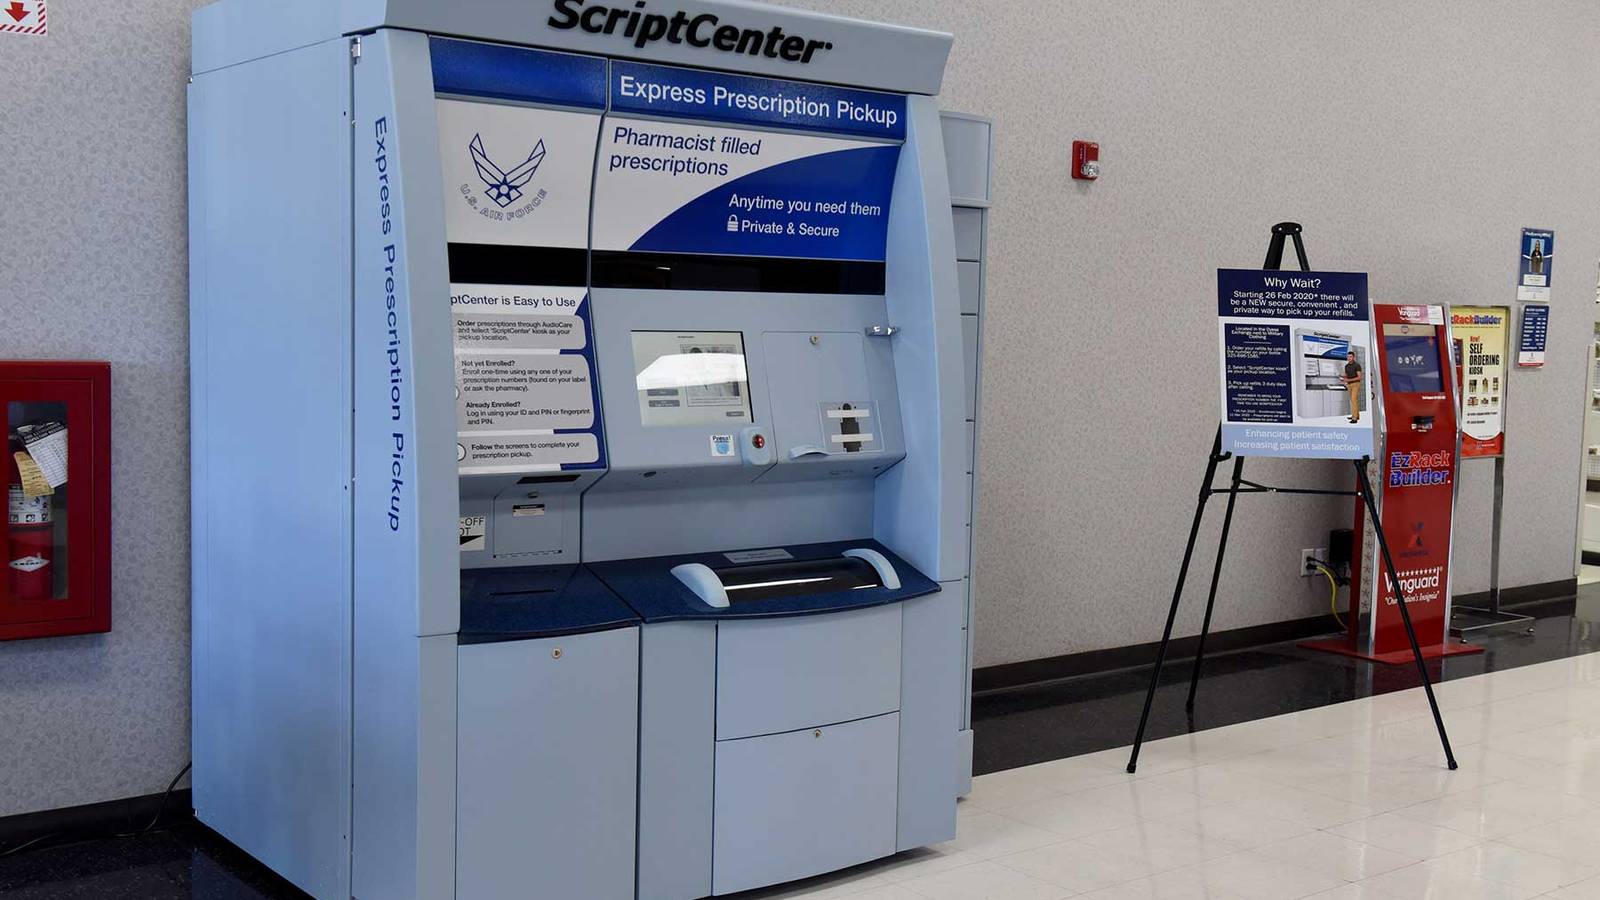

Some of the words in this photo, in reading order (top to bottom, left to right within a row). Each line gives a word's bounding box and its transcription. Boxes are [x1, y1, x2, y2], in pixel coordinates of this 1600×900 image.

[547, 0, 825, 63] ScriptCenter
[620, 75, 706, 104] Express
[714, 86, 829, 117] Prescription
[837, 101, 897, 128] Pickup
[614, 127, 715, 152] Pharmacist
[720, 137, 761, 155] filled
[609, 153, 729, 176] prescriptions
[375, 116, 392, 235] Express
[480, 207, 504, 221] AIR
[506, 188, 547, 221] FORCE
[729, 194, 784, 211] Anytime
[788, 201, 811, 213] you
[815, 201, 846, 214] need
[850, 202, 881, 216] them
[742, 220, 782, 234] Private
[786, 223, 795, 234] &
[799, 223, 839, 236] Secure
[1264, 277, 1288, 289] Why
[1290, 279, 1321, 288] Wait?
[450, 294, 499, 306] ptCenter
[501, 296, 511, 305] is
[513, 296, 539, 308] Easy
[542, 298, 553, 307] to
[556, 298, 576, 307] Use
[1234, 291, 1264, 299] Starting
[1286, 308, 1302, 316] pick
[383, 244, 402, 420] Prescription
[1470, 343, 1483, 354] SELF
[1469, 354, 1500, 366] ORDERING
[1469, 366, 1483, 374] KIOSK
[1246, 430, 1290, 440] Enhancing
[1291, 431, 1320, 440] patient
[1322, 431, 1348, 440] safety
[1234, 440, 1279, 450] Increasing
[1280, 441, 1310, 451] patient
[1312, 441, 1359, 451] satisfaction
[1391, 450, 1450, 468] EzRack
[388, 432, 404, 531] Pickup
[1384, 566, 1440, 593] Vnguard
